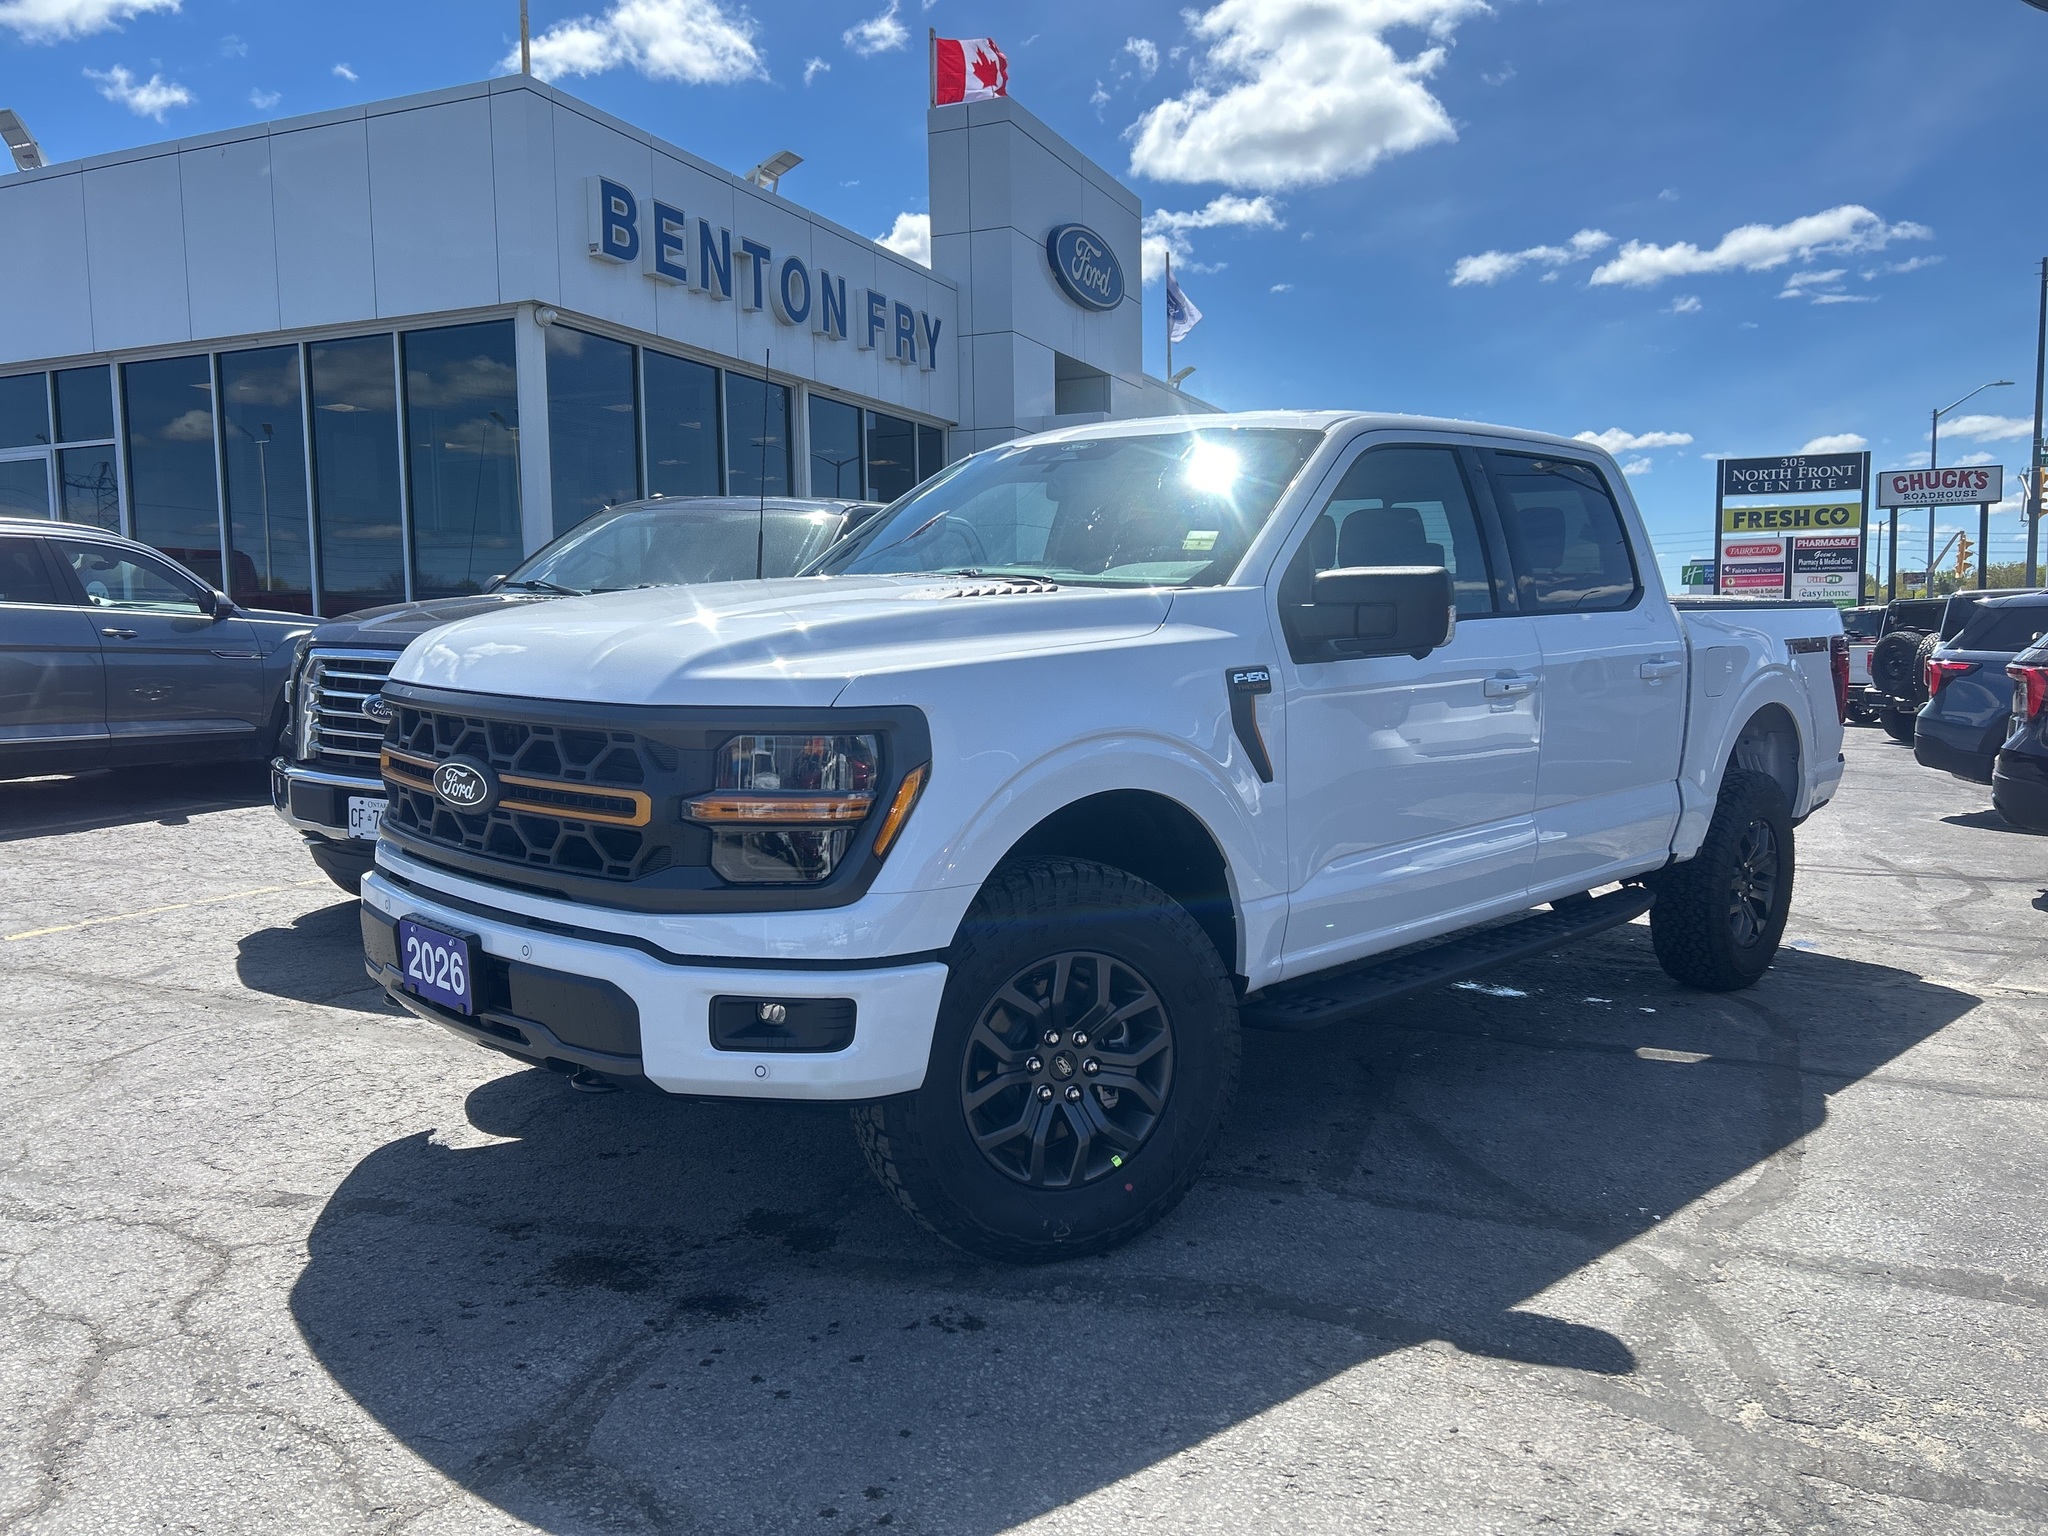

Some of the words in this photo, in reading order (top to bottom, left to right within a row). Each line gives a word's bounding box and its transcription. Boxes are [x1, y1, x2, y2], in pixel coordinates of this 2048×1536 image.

[587, 175, 848, 341] BENTON
[857, 288, 942, 372] FRY
[1071, 236, 1112, 298] Ford
[1780, 457, 1806, 468] 305
[1732, 467, 1792, 482] NORTH
[1797, 464, 1856, 479] FRONT
[1747, 478, 1837, 492] CENTRE
[1892, 469, 1990, 494] CHUCK'S
[1903, 490, 1978, 500] ROADHOUSE
[1733, 508, 1811, 529] FRESH
[1729, 546, 1778, 556] FABRICLAND
[1797, 538, 1857, 548] PHARMASAVE
[1798, 558, 1819, 567] Pharmacy
[1824, 557, 1841, 565] Medical
[1841, 557, 1854, 565] Clinic
[1801, 587, 1850, 600] easyhome
[1233, 671, 1269, 684] F-150
[371, 700, 394, 716] For
[442, 767, 476, 800] Ford
[351, 807, 365, 828] CF
[407, 936, 465, 996] 2026
